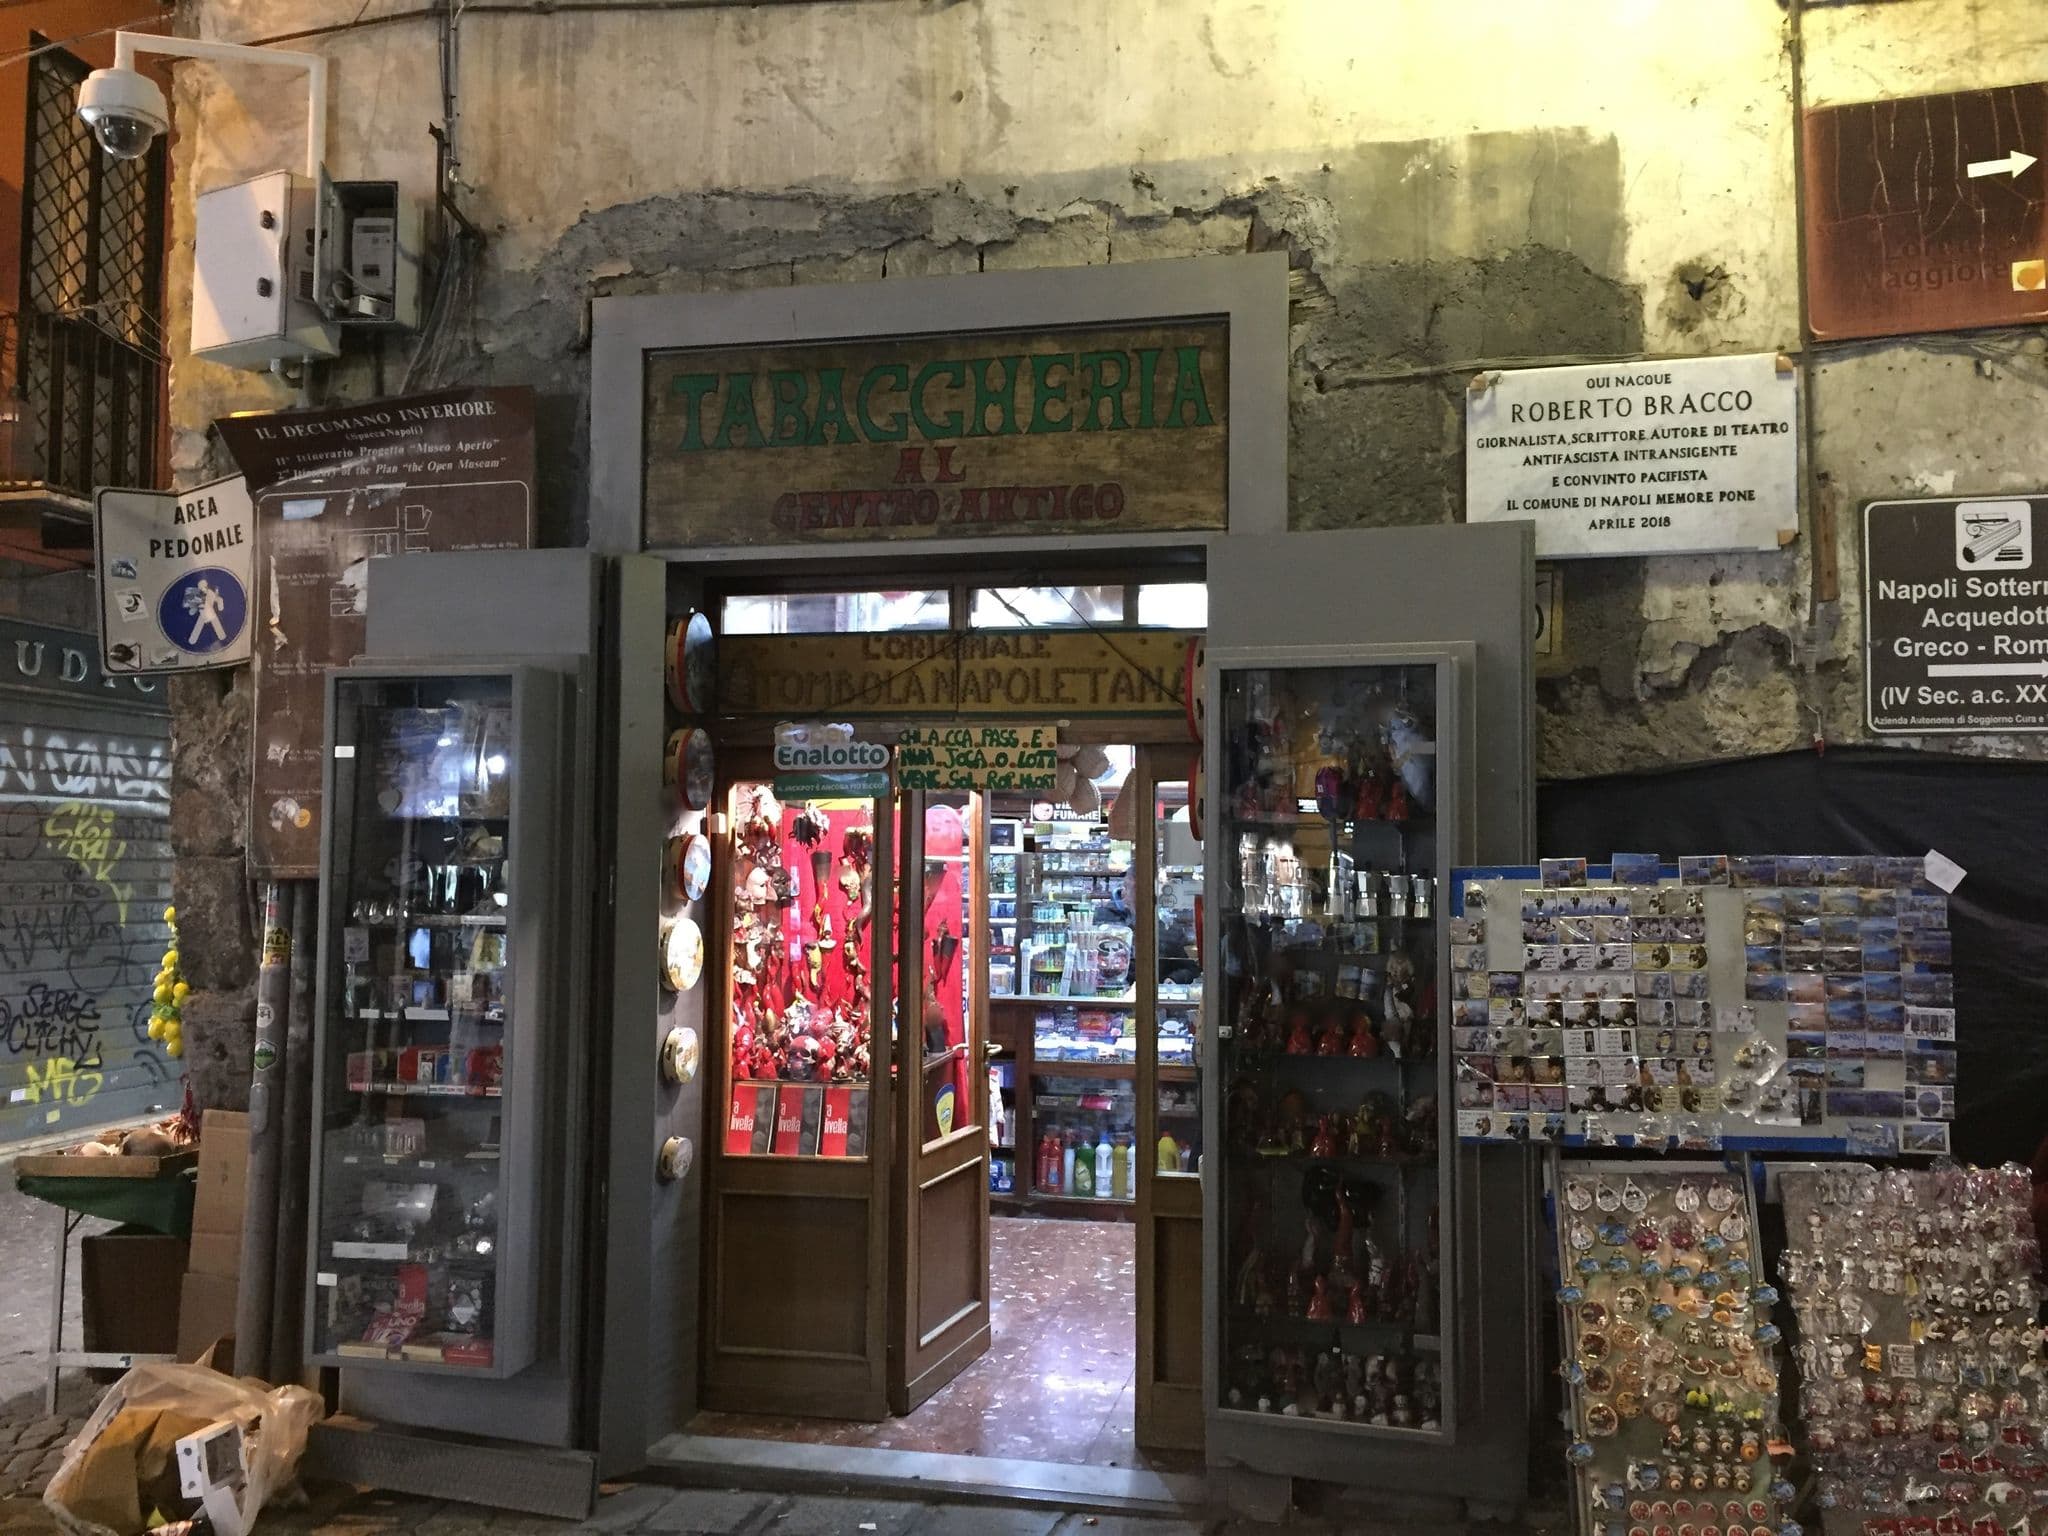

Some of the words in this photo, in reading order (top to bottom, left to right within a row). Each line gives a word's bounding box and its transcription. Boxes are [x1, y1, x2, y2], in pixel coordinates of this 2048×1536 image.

[1586, 376, 1611, 390] QUI
[671, 345, 1216, 452] TABACCHERIA
[1511, 397, 1633, 424] ROBERTO
[1644, 389, 1753, 416] BRACCO
[254, 426, 278, 441] IL
[281, 412, 392, 439] DECUMANO
[399, 400, 498, 422] INFERIORE
[1650, 426, 1709, 440] AUTORE
[1713, 425, 1728, 438] DI
[1731, 421, 1790, 436] TEATRO
[426, 459, 454, 474] Open
[892, 445, 967, 484] AL
[1522, 450, 1620, 467] ANTIFASCISTA
[1623, 444, 1739, 462] INTRANSIGENTE
[1551, 476, 1560, 488] E
[1563, 473, 1637, 488] CONVINTO
[1640, 469, 1709, 484] PACIFISTA
[174, 496, 219, 525] AREA
[952, 482, 1127, 525] ANTICO
[1506, 500, 1520, 512] IL
[1522, 497, 1580, 510] COMUNE
[1583, 496, 1597, 508] DI
[1600, 494, 1652, 507] NAPOLI
[1655, 491, 1714, 505] MEMORE
[1719, 489, 1757, 503] PONE
[1588, 517, 1636, 531] APRILE
[1640, 515, 1672, 528] 2018
[150, 523, 244, 559] PEDONALE
[1877, 578, 1958, 604] Napoli
[1893, 637, 1970, 658] Greco
[1880, 686, 1912, 710] (IV
[1917, 684, 1966, 705] Sec.
[1971, 687, 2011, 705] a.c.
[1873, 716, 1908, 726] Azienda
[1910, 715, 1955, 725] Autonoma
[1957, 714, 1966, 725] di
[1967, 714, 2014, 727] Soggiorno
[2015, 714, 2037, 724] Cura
[777, 744, 886, 766] Enalotto
